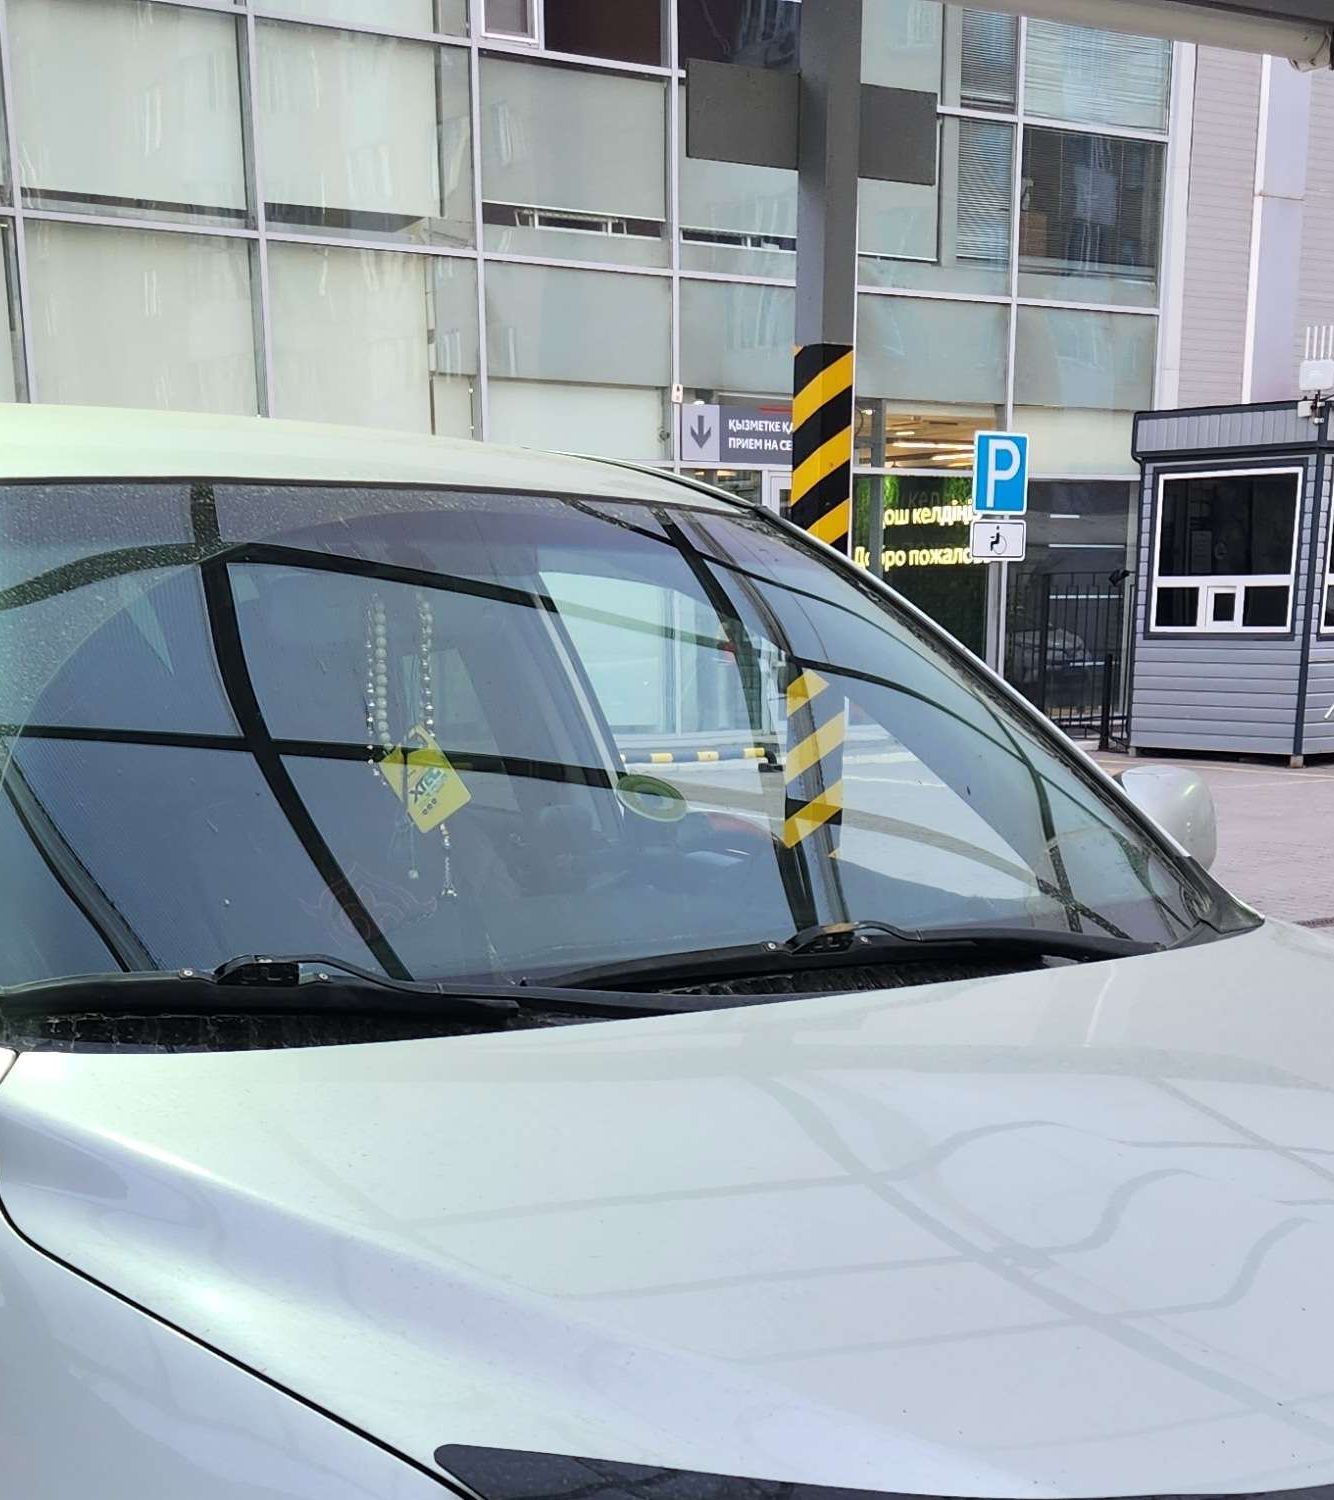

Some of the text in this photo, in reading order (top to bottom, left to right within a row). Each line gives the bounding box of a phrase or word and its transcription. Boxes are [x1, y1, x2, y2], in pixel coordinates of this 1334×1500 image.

[728, 419, 781, 433] ҚЫЗМЕТКЕ
[728, 437, 762, 450] ПРИЕМ
[764, 439, 778, 451] НА
[985, 438, 1021, 509] P
[883, 508, 908, 529] ош
[854, 546, 906, 572] Дро
